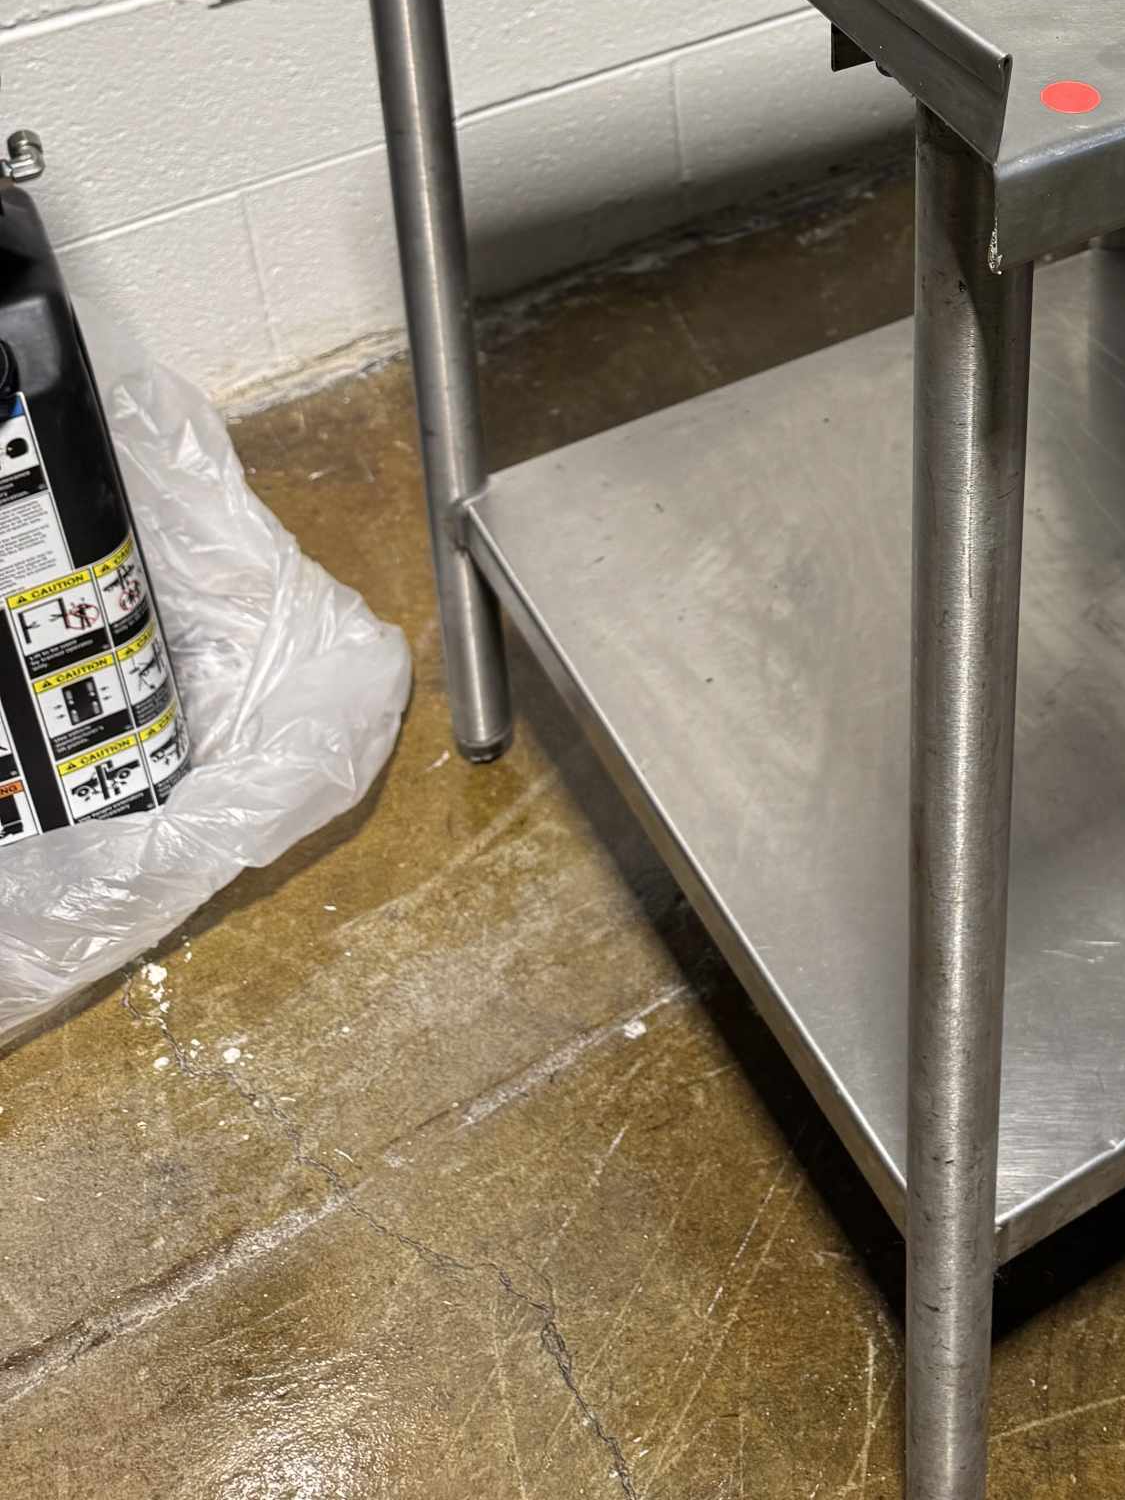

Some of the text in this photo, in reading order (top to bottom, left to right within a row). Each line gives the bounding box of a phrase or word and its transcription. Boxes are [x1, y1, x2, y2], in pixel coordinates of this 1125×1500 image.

[31, 575, 84, 598] CAUTION
[56, 658, 108, 683] CAUTION
[81, 739, 131, 764] CAUTION
